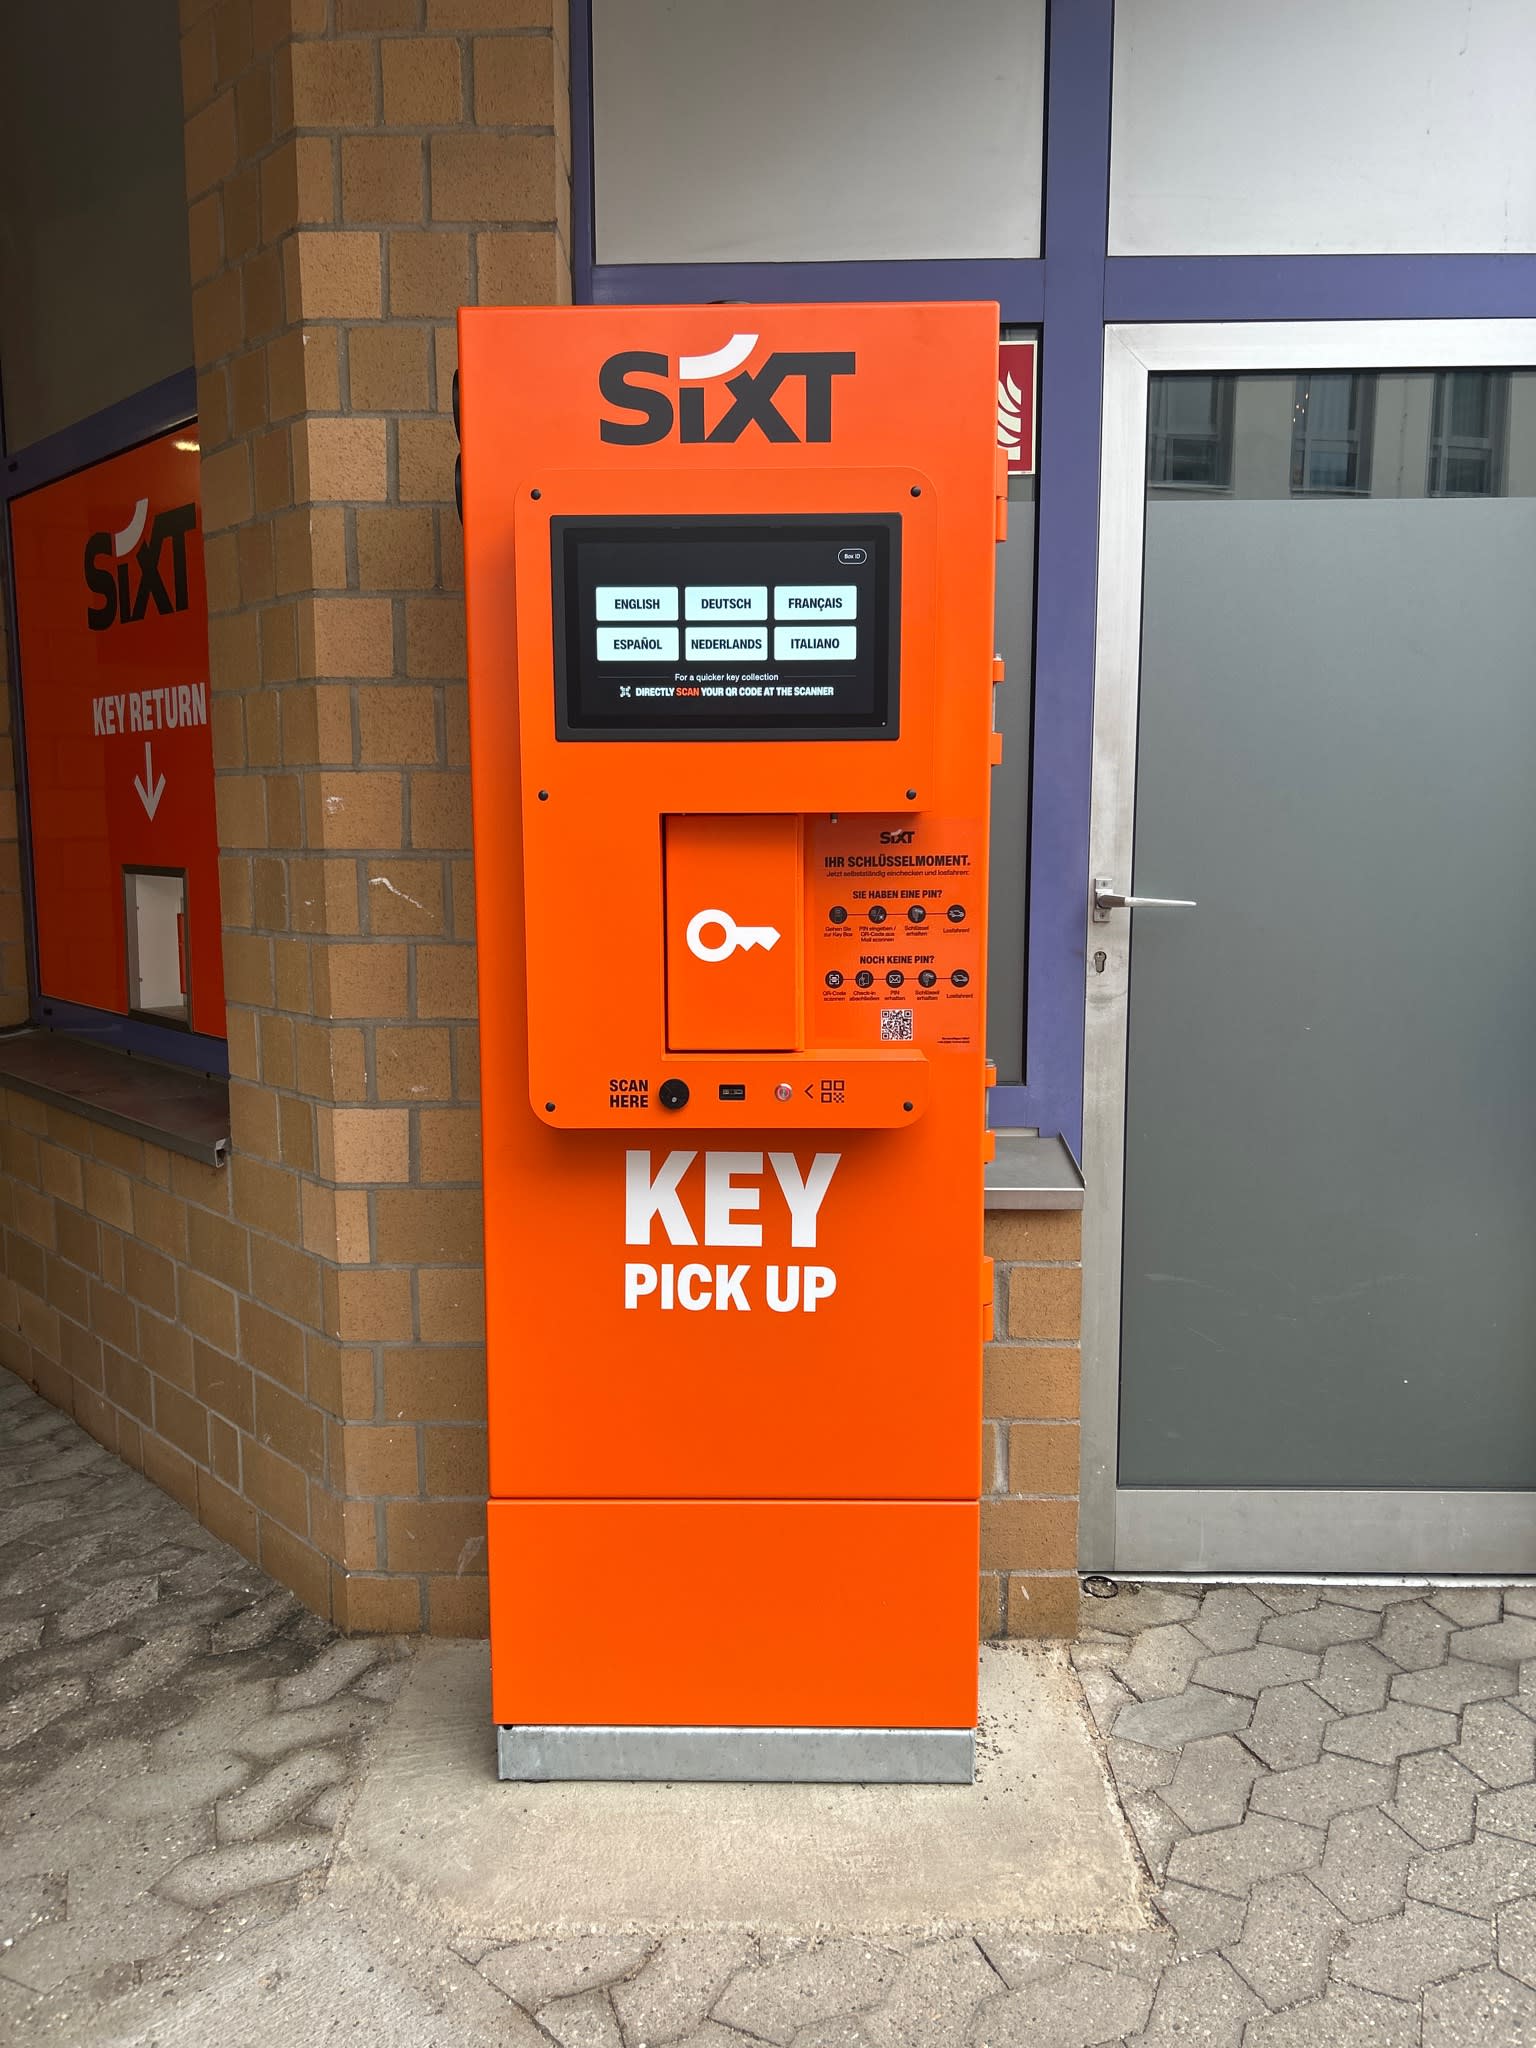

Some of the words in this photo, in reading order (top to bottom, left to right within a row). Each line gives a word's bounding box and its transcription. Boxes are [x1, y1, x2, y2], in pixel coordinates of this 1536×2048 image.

[614, 598, 660, 610] ENGLISH
[701, 598, 752, 610] DEUTSCH
[788, 597, 842, 612] FRANÇAIS
[613, 636, 662, 650] ESPAÑOL
[691, 638, 762, 650] NEDERLANDS
[790, 638, 840, 650] ITALIANO
[697, 674, 725, 682] quicker
[726, 674, 740, 682] key
[636, 688, 675, 696] DIRECTLY
[676, 688, 700, 696] SCAN
[701, 687, 724, 696] YOUR
[725, 687, 738, 696] QR
[739, 687, 762, 696] CODE
[764, 687, 774, 696] AT
[776, 687, 793, 696] THE
[794, 687, 834, 696] SCANNER
[92, 693, 126, 736] KEY
[129, 682, 207, 733] RETURN
[825, 856, 844, 868] IHR
[848, 854, 971, 867] SCHLÜSSELMOMENT.
[852, 890, 866, 899] SIE
[868, 890, 898, 898] HABEN
[900, 890, 920, 898] EINE
[922, 889, 942, 898] PIN?
[860, 956, 884, 964] NOCH
[887, 956, 912, 964] KEINE
[914, 955, 934, 964] PIN?
[609, 1079, 648, 1092] SCAN
[609, 1095, 648, 1108] HERE
[625, 1150, 842, 1248] KEY
[624, 1263, 752, 1312] PICK
[766, 1265, 838, 1312] UP
